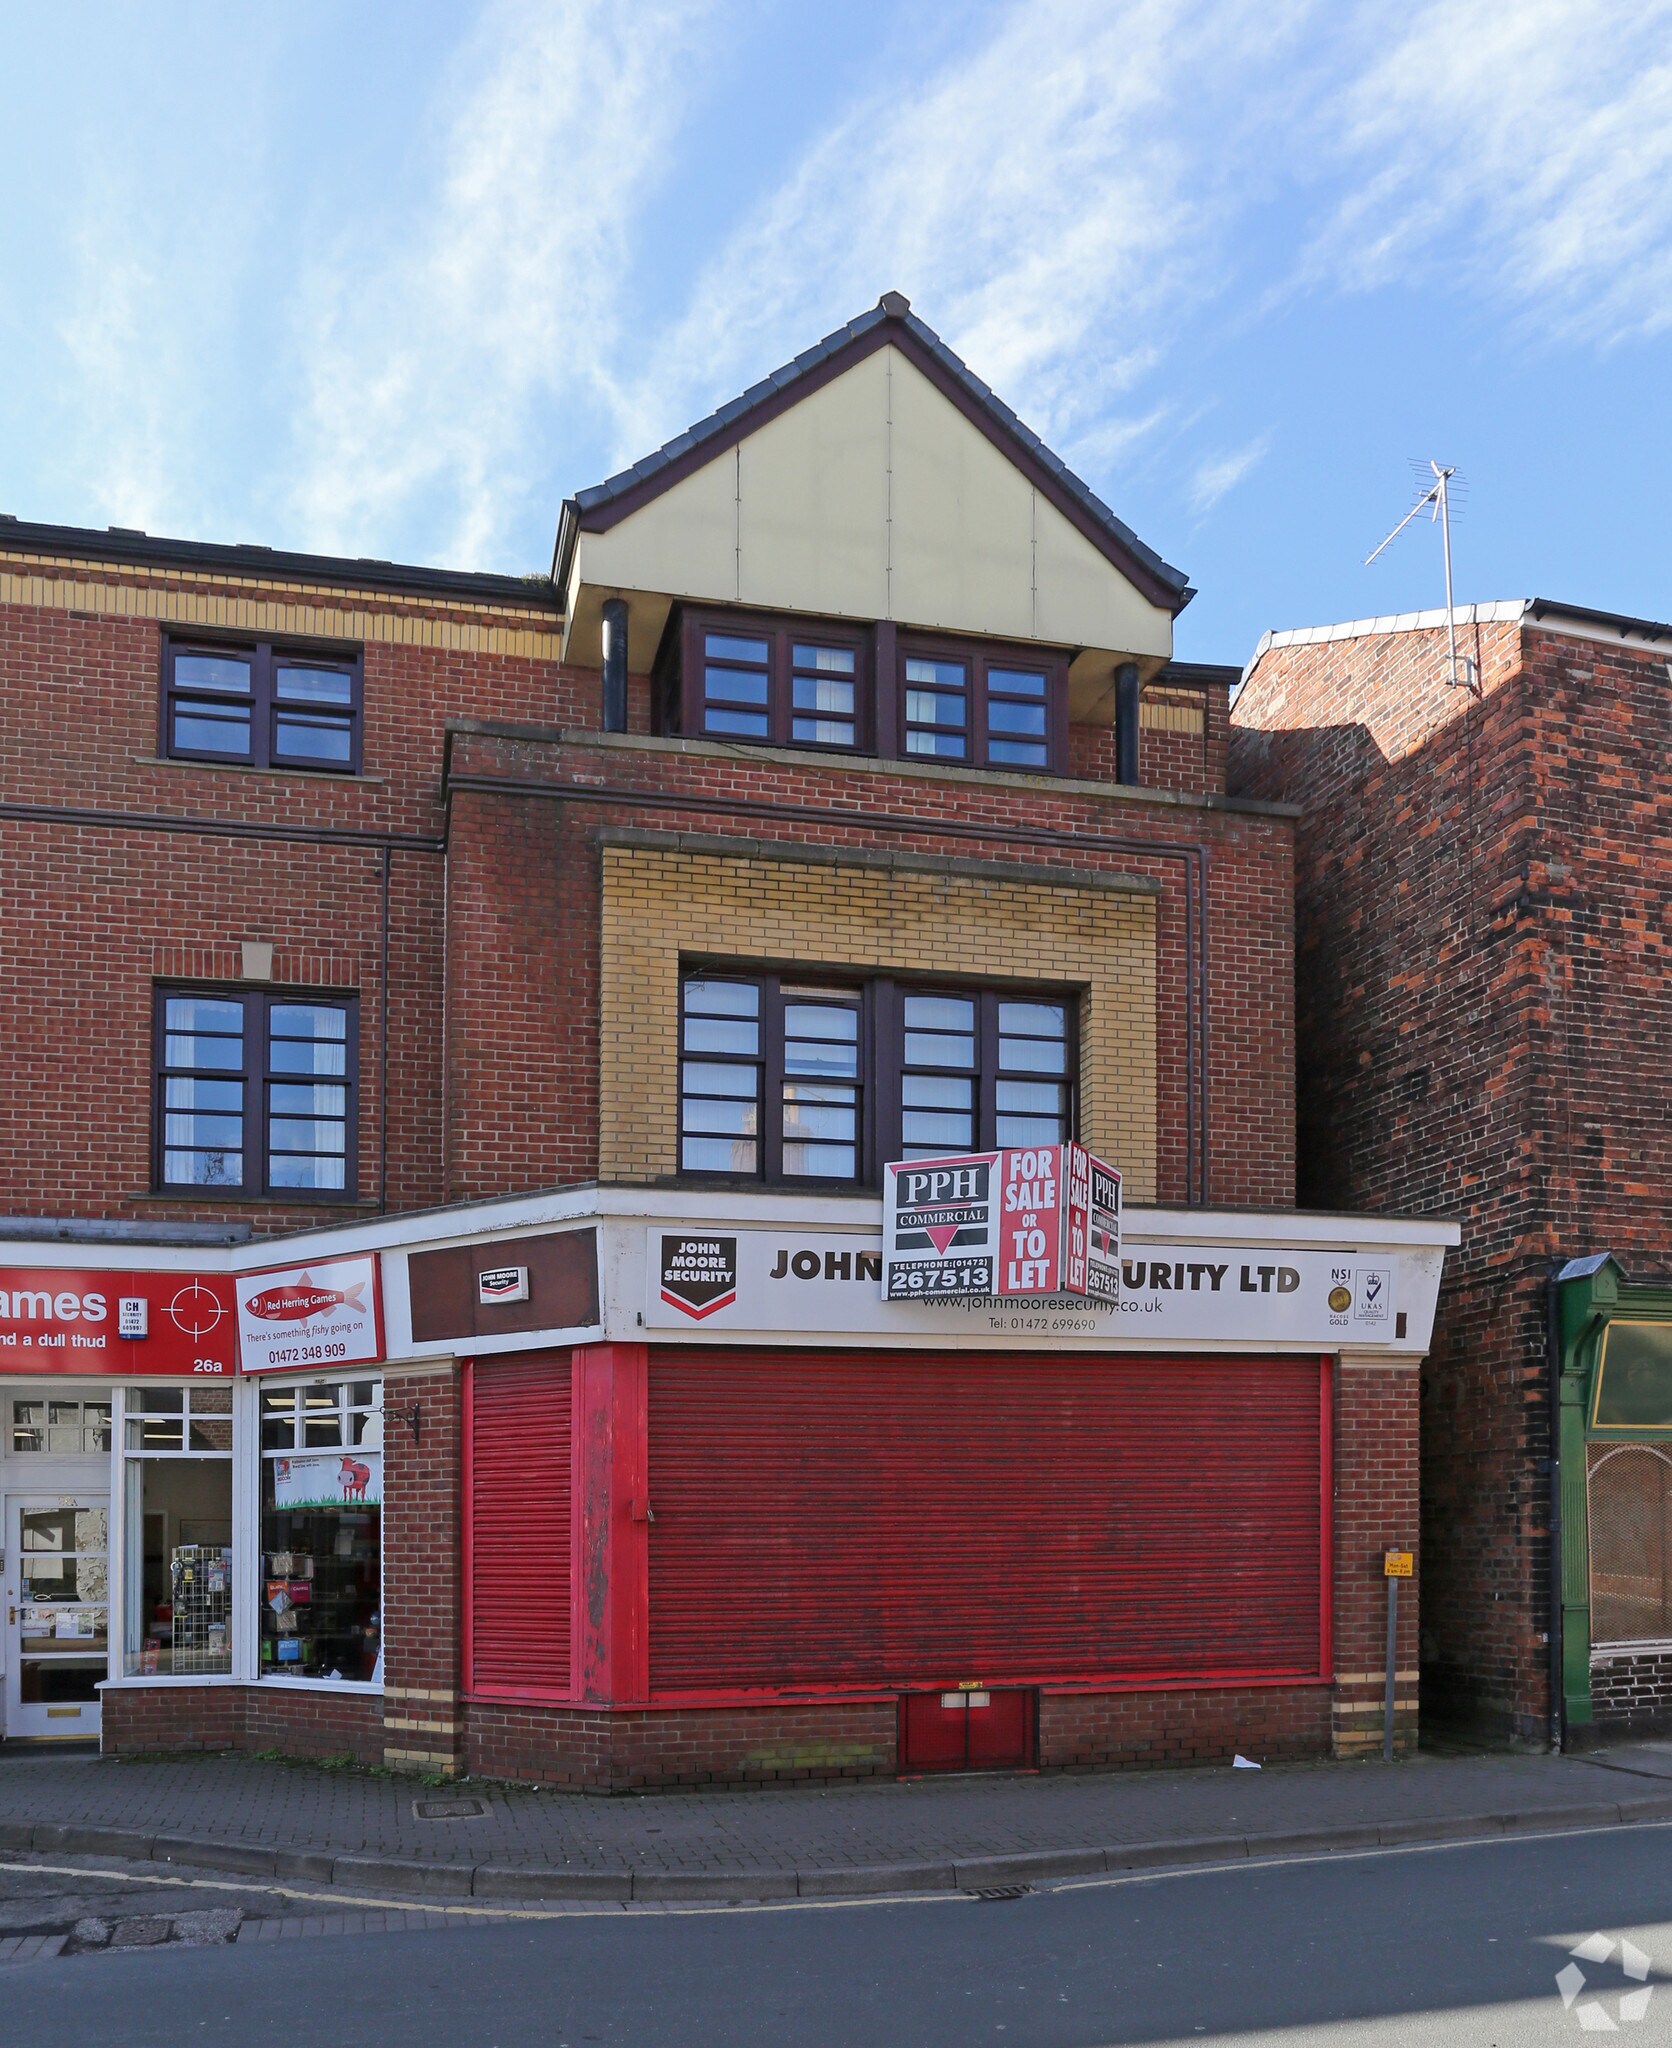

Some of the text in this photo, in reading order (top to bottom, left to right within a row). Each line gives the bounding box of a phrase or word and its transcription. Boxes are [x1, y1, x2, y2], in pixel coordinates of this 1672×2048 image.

[1010, 1150, 1053, 1181] FOR
[1073, 1146, 1087, 1181] FOR
[905, 1168, 980, 1203] PPH
[1071, 1176, 1088, 1210] SALE
[1095, 1171, 1117, 1211] PPH
[1005, 1180, 1056, 1212] SALE
[900, 1209, 985, 1226] COMMERCIAL
[1022, 1214, 1037, 1228] OR
[679, 1242, 720, 1254] JOHN
[1012, 1229, 1046, 1259] TO
[1072, 1227, 1084, 1257] TO
[671, 1256, 726, 1268] MOORE
[769, 1250, 882, 1281] JOHN
[1240, 1265, 1300, 1293] LTD
[1070, 1255, 1084, 1288] LET
[496, 1271, 517, 1280] MOORE
[664, 1270, 733, 1282] SECURITY
[891, 1267, 989, 1289] 267513
[1008, 1259, 1050, 1290] LET
[1088, 1269, 1119, 1295] 267513
[1331, 1268, 1351, 1279] NSI
[890, 1286, 990, 1297] www.pph-commercial.co.uk
[126, 1302, 139, 1311] CH
[267, 1294, 336, 1310] Red Herring Games
[246, 1322, 364, 1343] There's something fishy going on
[989, 1318, 1096, 1331] Tel: 01472 699690
[23, 1336, 32, 1346] a
[38, 1334, 66, 1347] dull
[71, 1335, 106, 1348] thud
[269, 1343, 346, 1363] 01472 348 909
[193, 1359, 223, 1372] 26a
